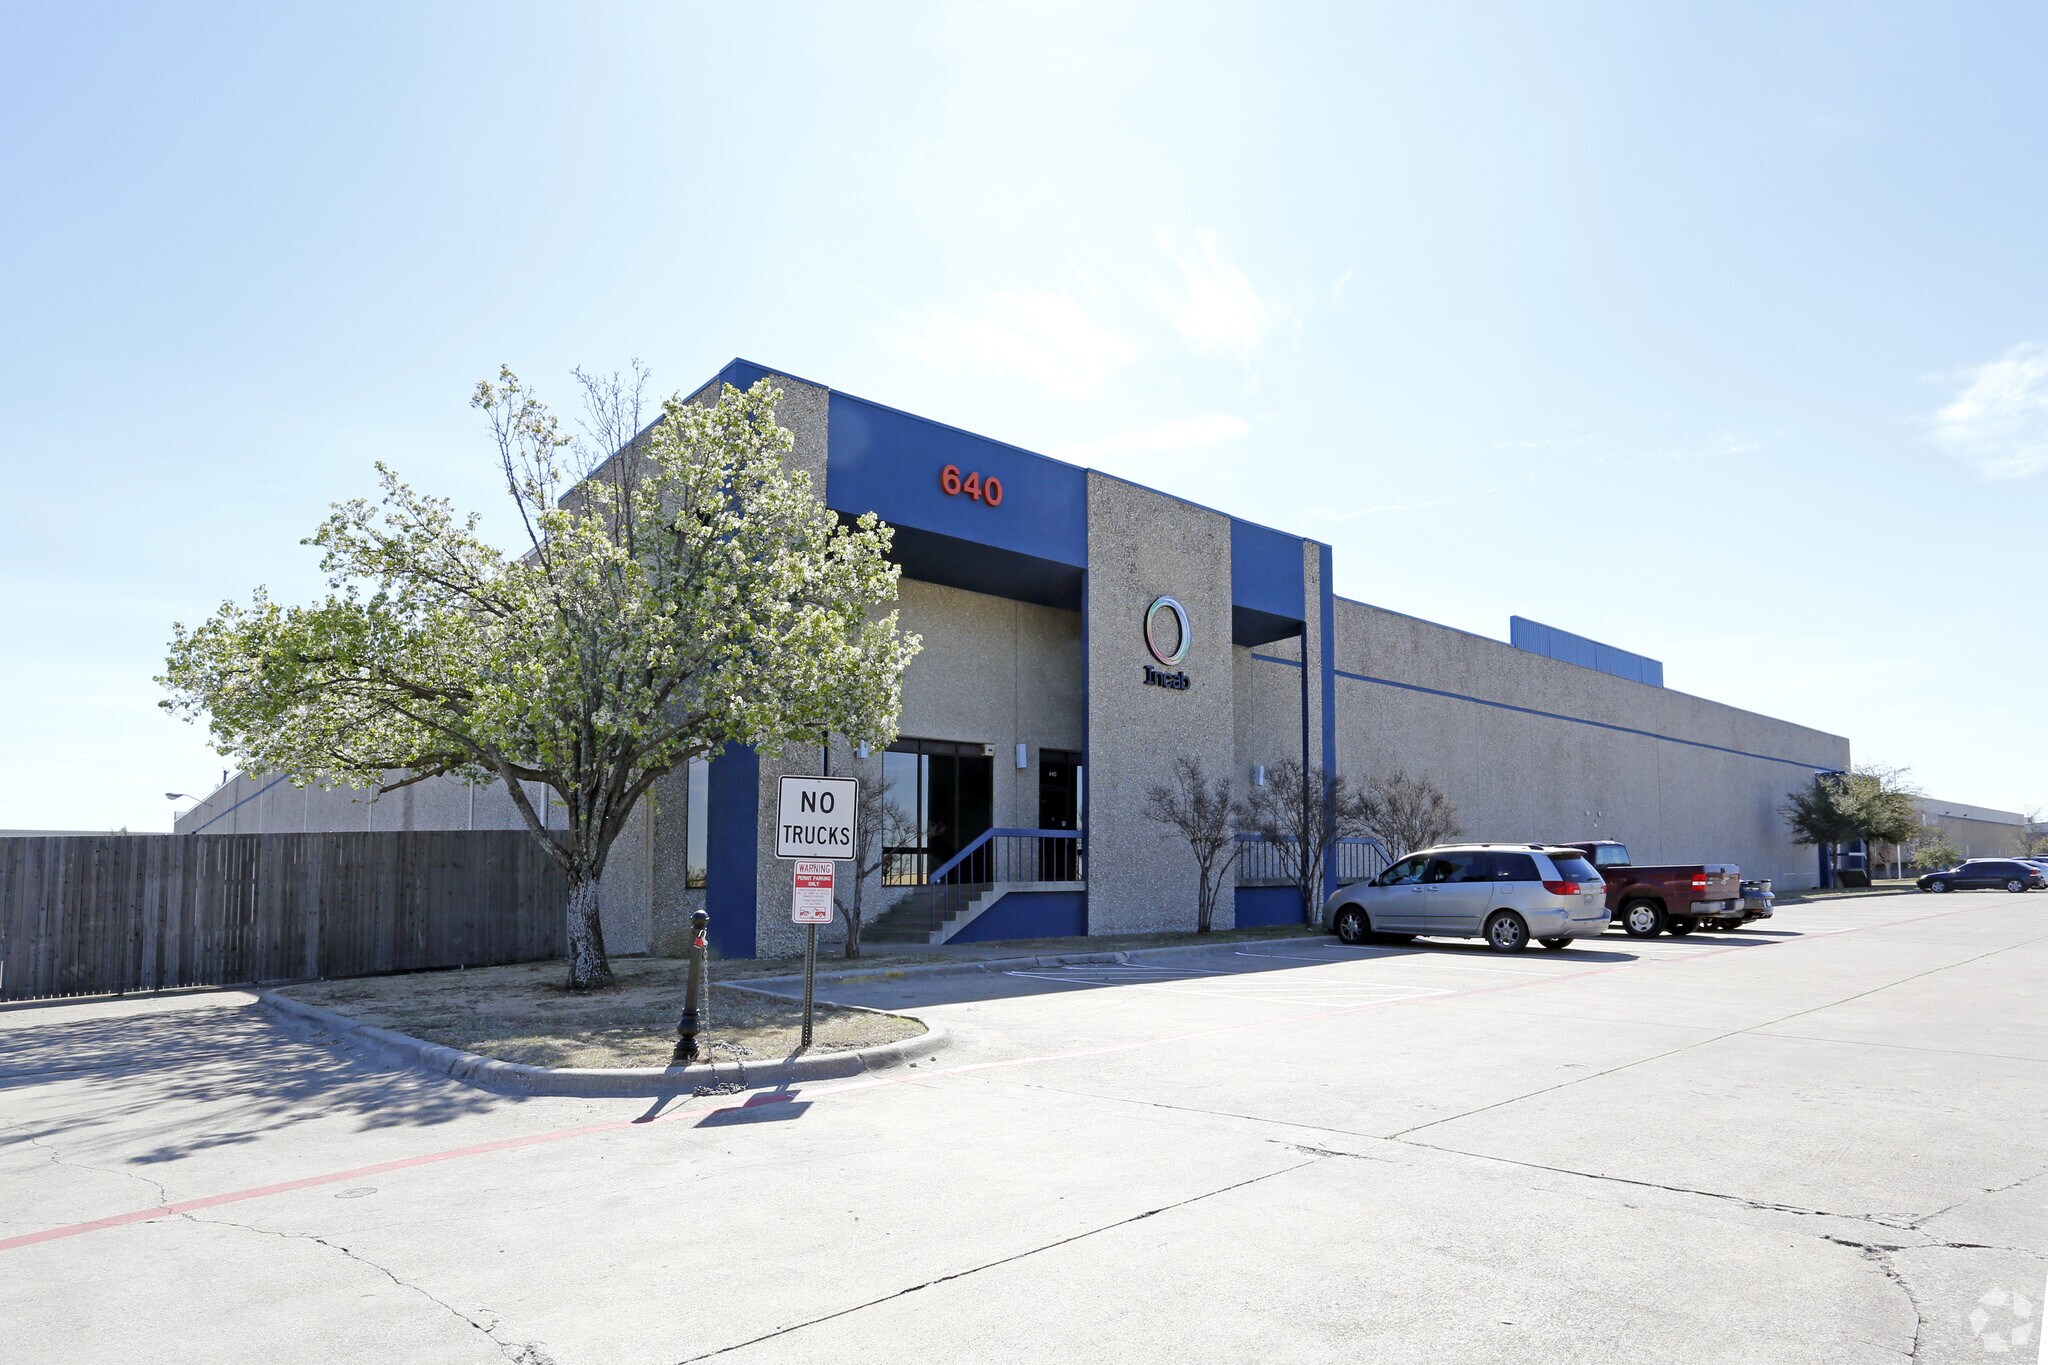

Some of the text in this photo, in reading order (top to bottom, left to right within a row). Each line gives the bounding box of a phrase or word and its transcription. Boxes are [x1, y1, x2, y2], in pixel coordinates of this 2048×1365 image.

[941, 464, 1003, 507] 640
[1143, 665, 1191, 691] Incab
[801, 791, 834, 814] NO
[783, 825, 850, 846] TRUCKS
[799, 864, 830, 874] WARNING
